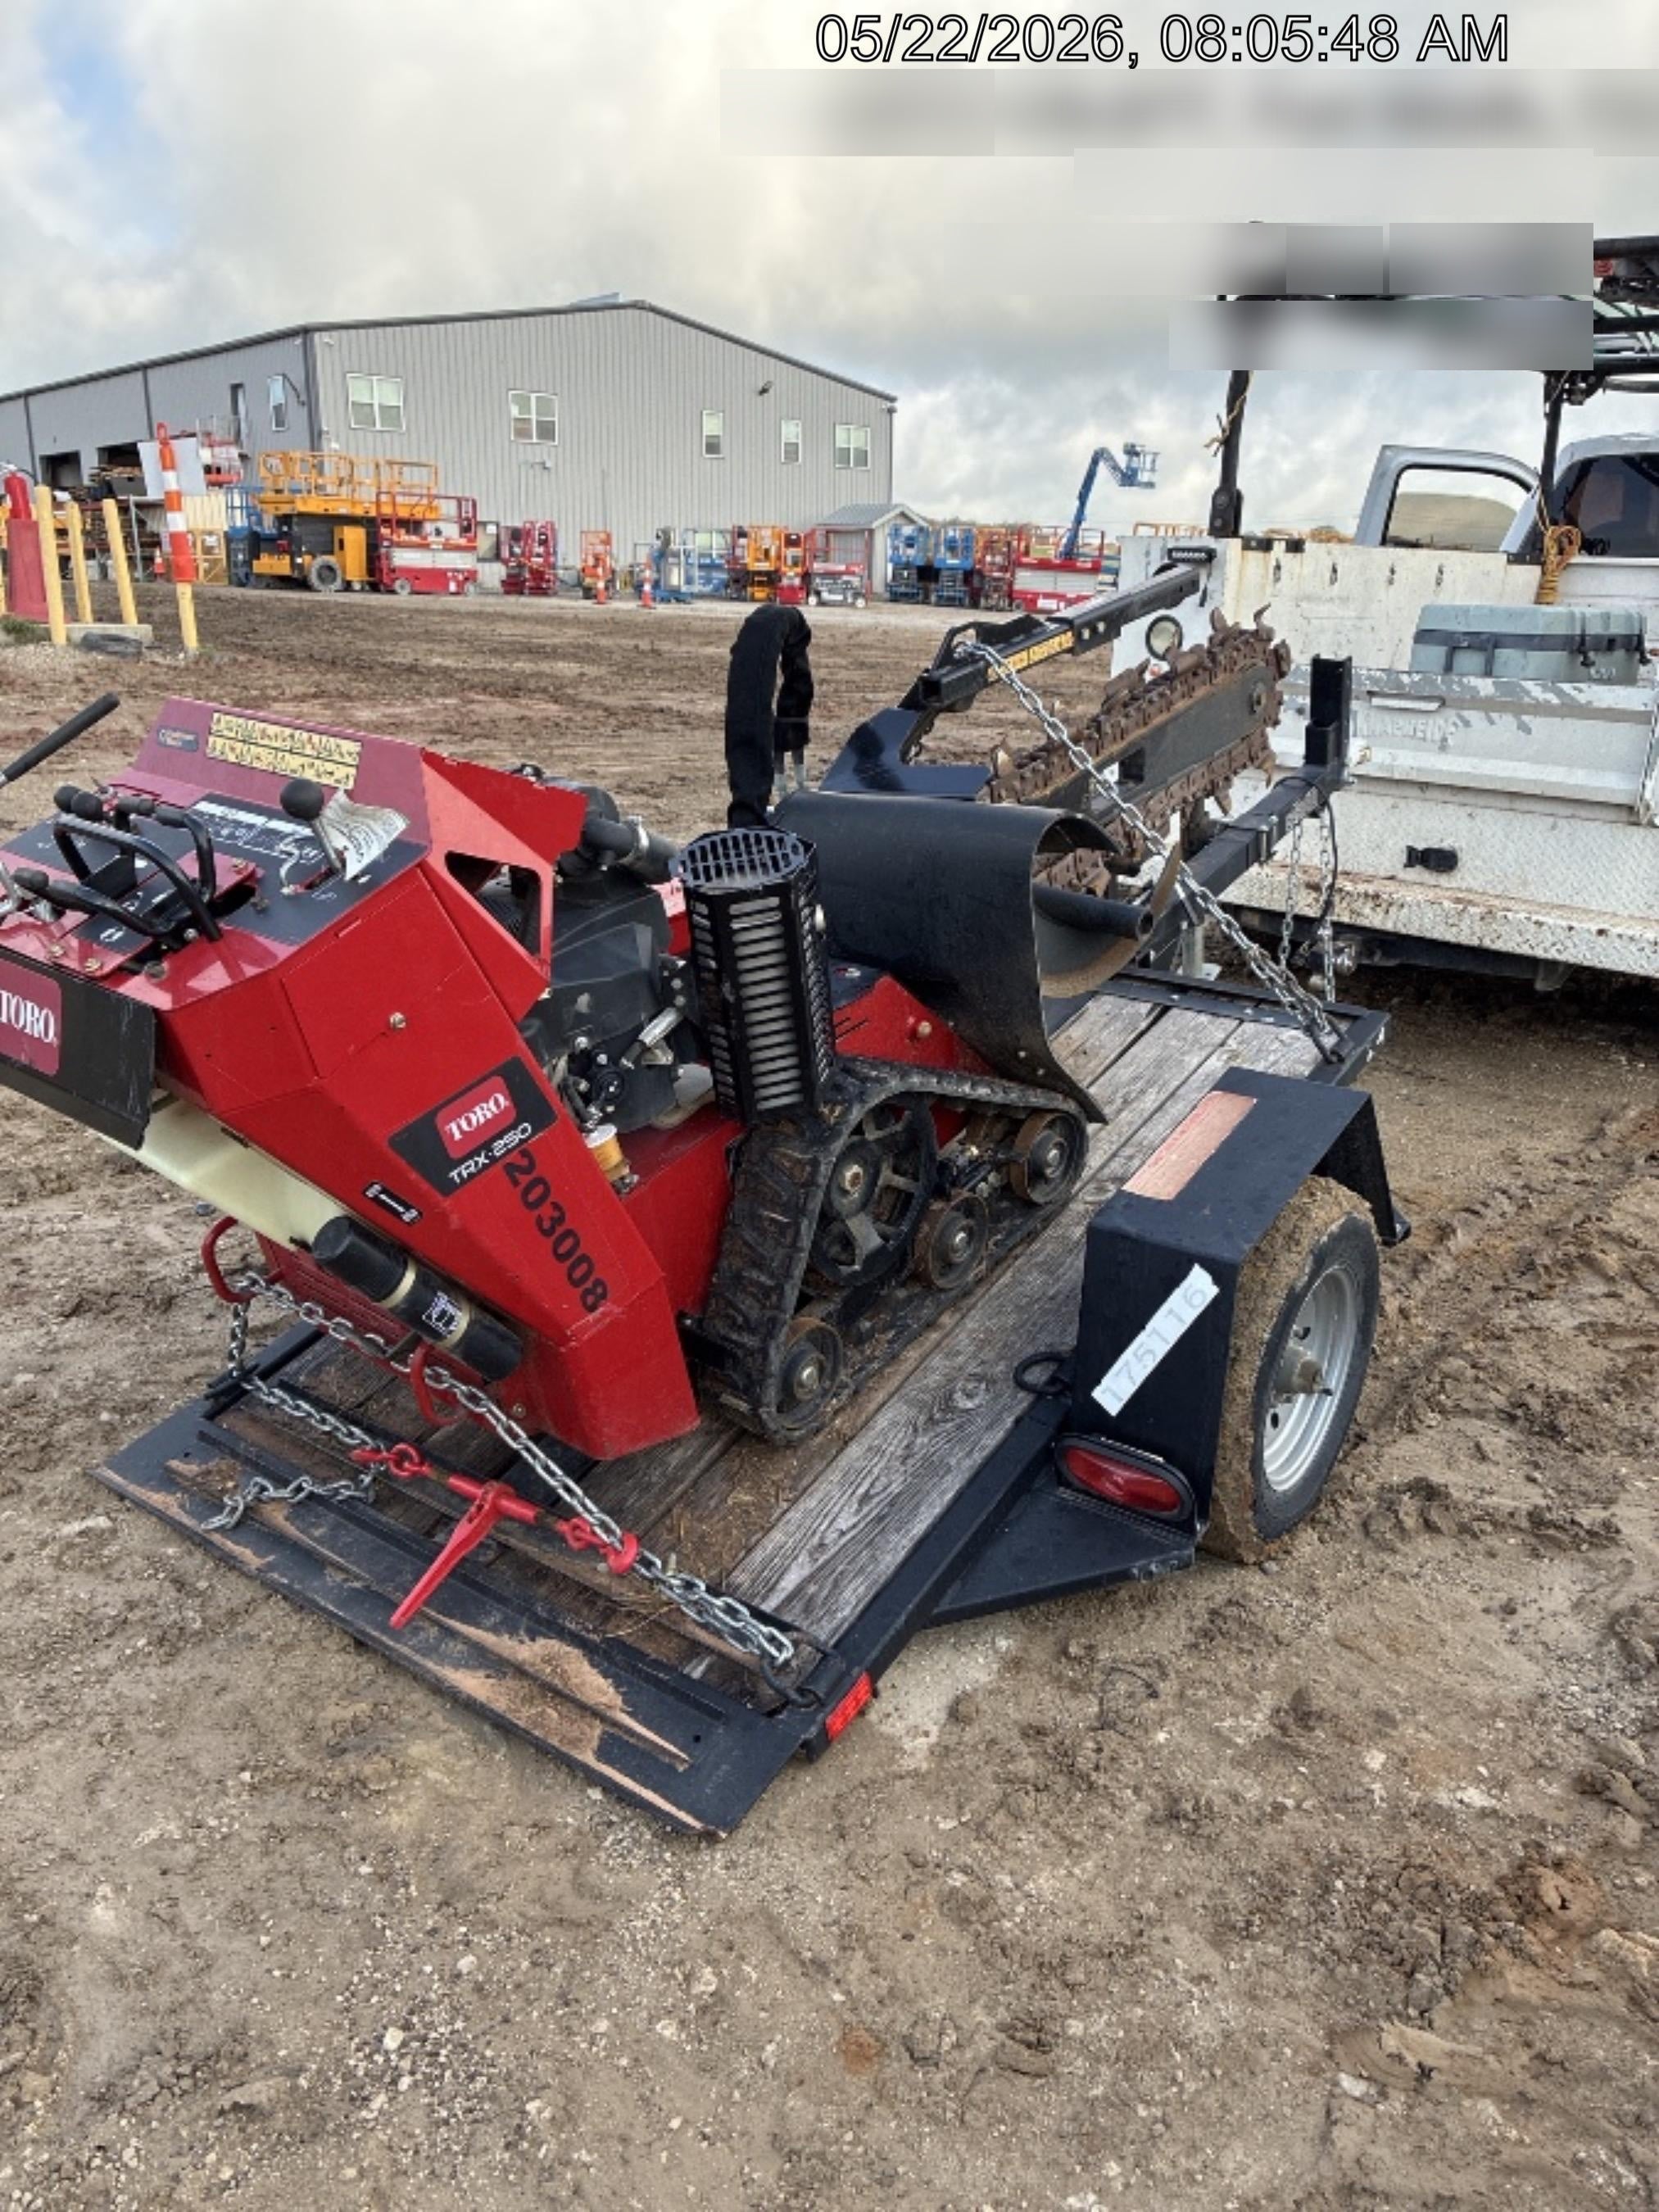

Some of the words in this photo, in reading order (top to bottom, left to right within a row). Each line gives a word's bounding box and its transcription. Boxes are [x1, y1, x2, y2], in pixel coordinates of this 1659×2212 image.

[0, 989, 55, 1044] TORO
[445, 1093, 506, 1141] TORO
[503, 1148, 608, 1313] 203008
[1101, 1283, 1208, 1403] 175116
